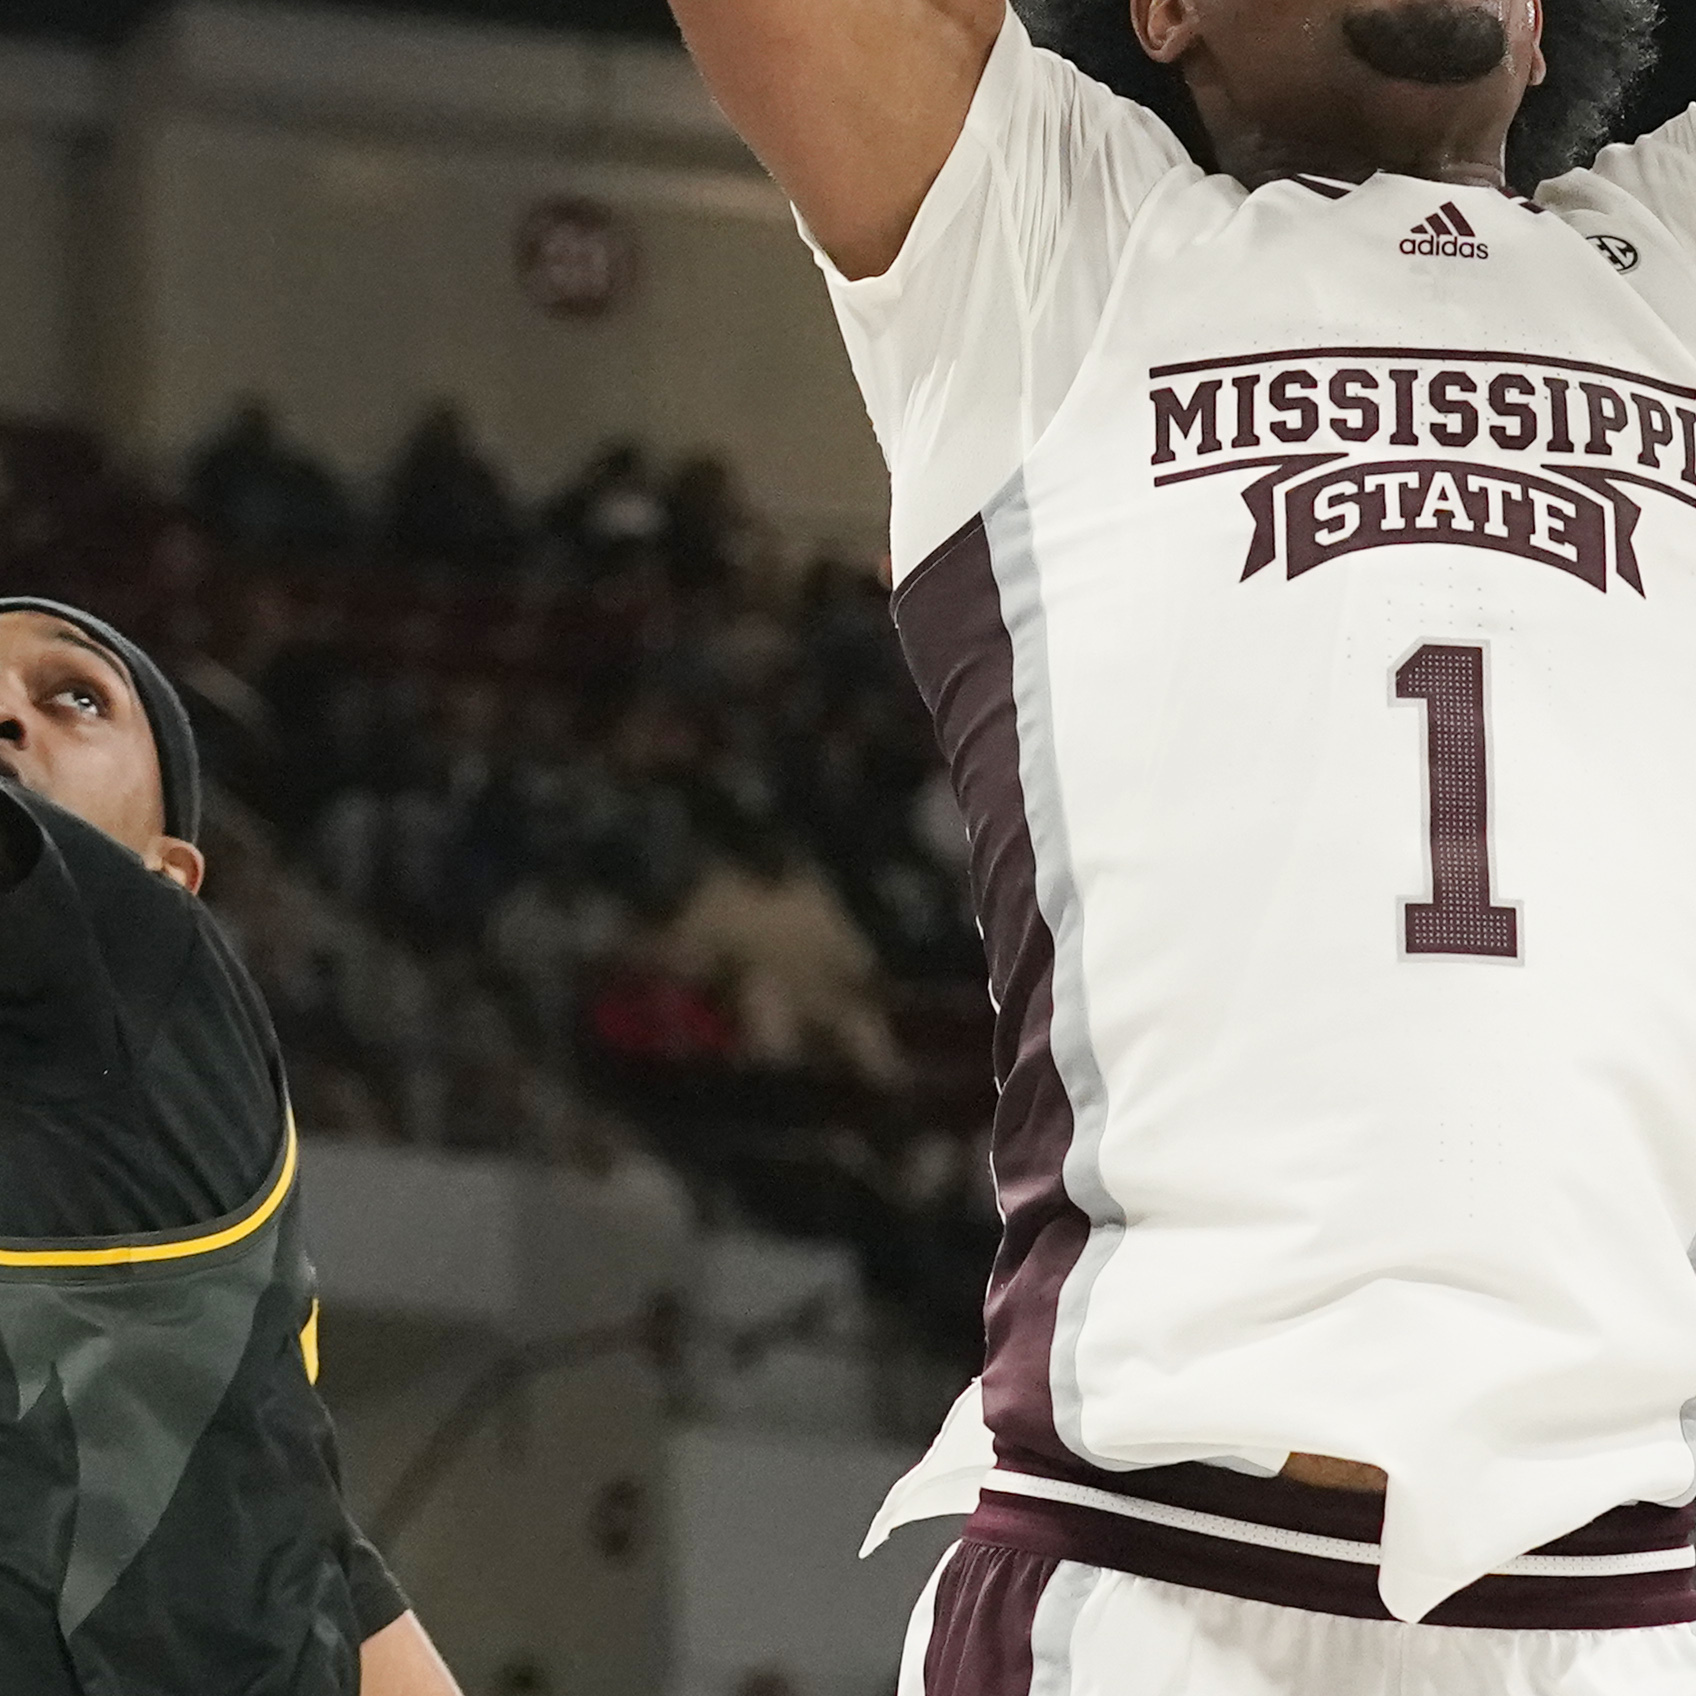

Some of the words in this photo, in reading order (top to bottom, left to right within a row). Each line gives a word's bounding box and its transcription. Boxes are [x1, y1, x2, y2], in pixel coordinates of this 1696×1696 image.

[1398, 234, 1489, 260] adidas
[1312, 470, 1580, 563] STATE
[1387, 636, 1525, 967] 1
